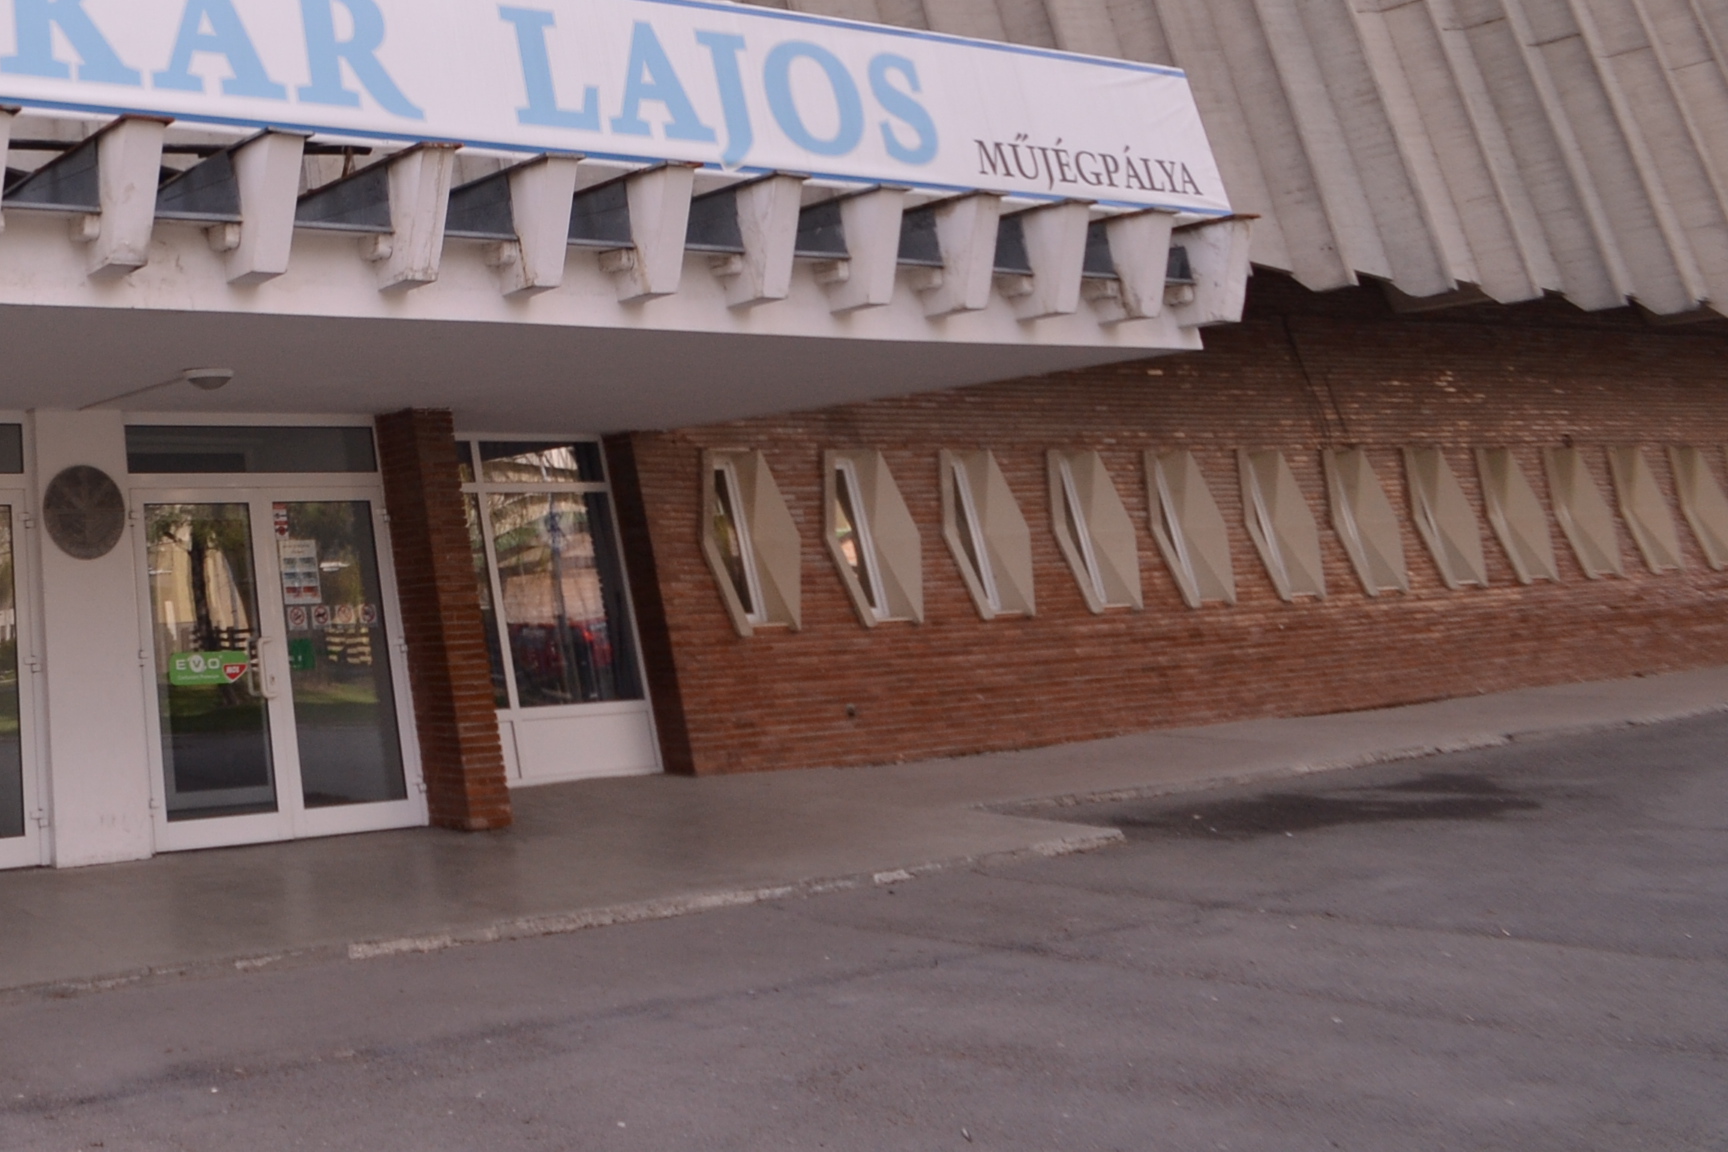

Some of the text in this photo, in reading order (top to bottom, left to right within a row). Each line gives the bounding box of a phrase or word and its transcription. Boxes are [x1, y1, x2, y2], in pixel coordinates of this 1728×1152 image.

[497, 4, 940, 171] LAJOS
[973, 132, 1204, 196] MŰJÉGPÁLYA
[175, 654, 220, 673] EVO
